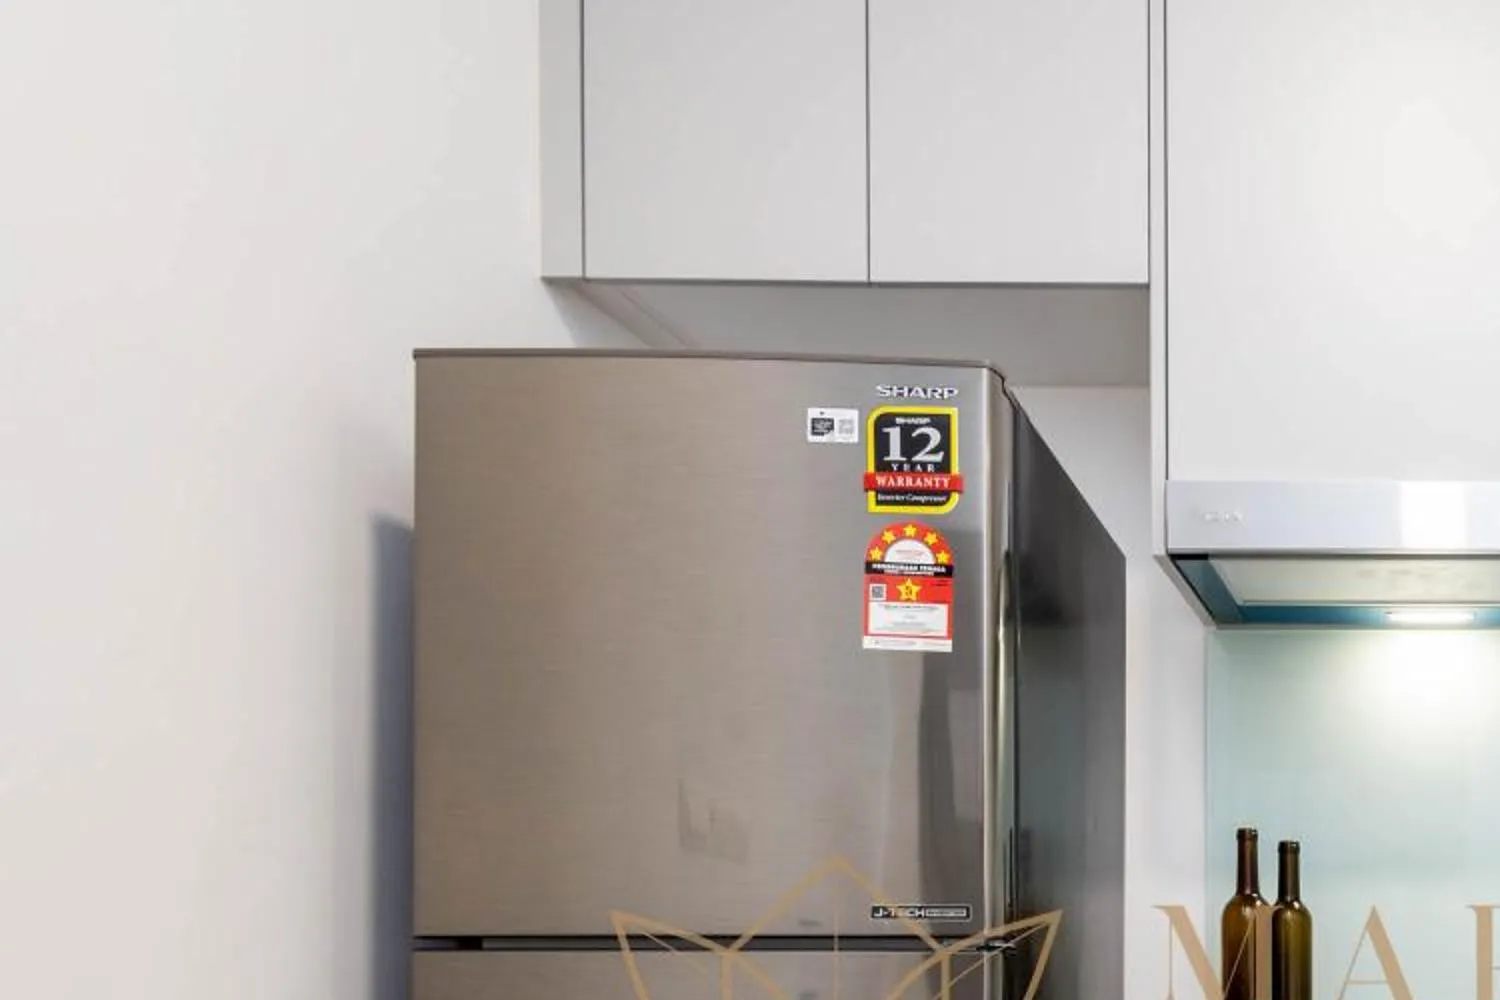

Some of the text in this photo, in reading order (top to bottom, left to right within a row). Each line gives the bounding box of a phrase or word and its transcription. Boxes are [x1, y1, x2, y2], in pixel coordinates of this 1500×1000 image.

[875, 384, 959, 399] SHARP
[882, 426, 945, 462] 12
[891, 463, 935, 473] YEAR
[875, 475, 950, 488] WARRANTY
